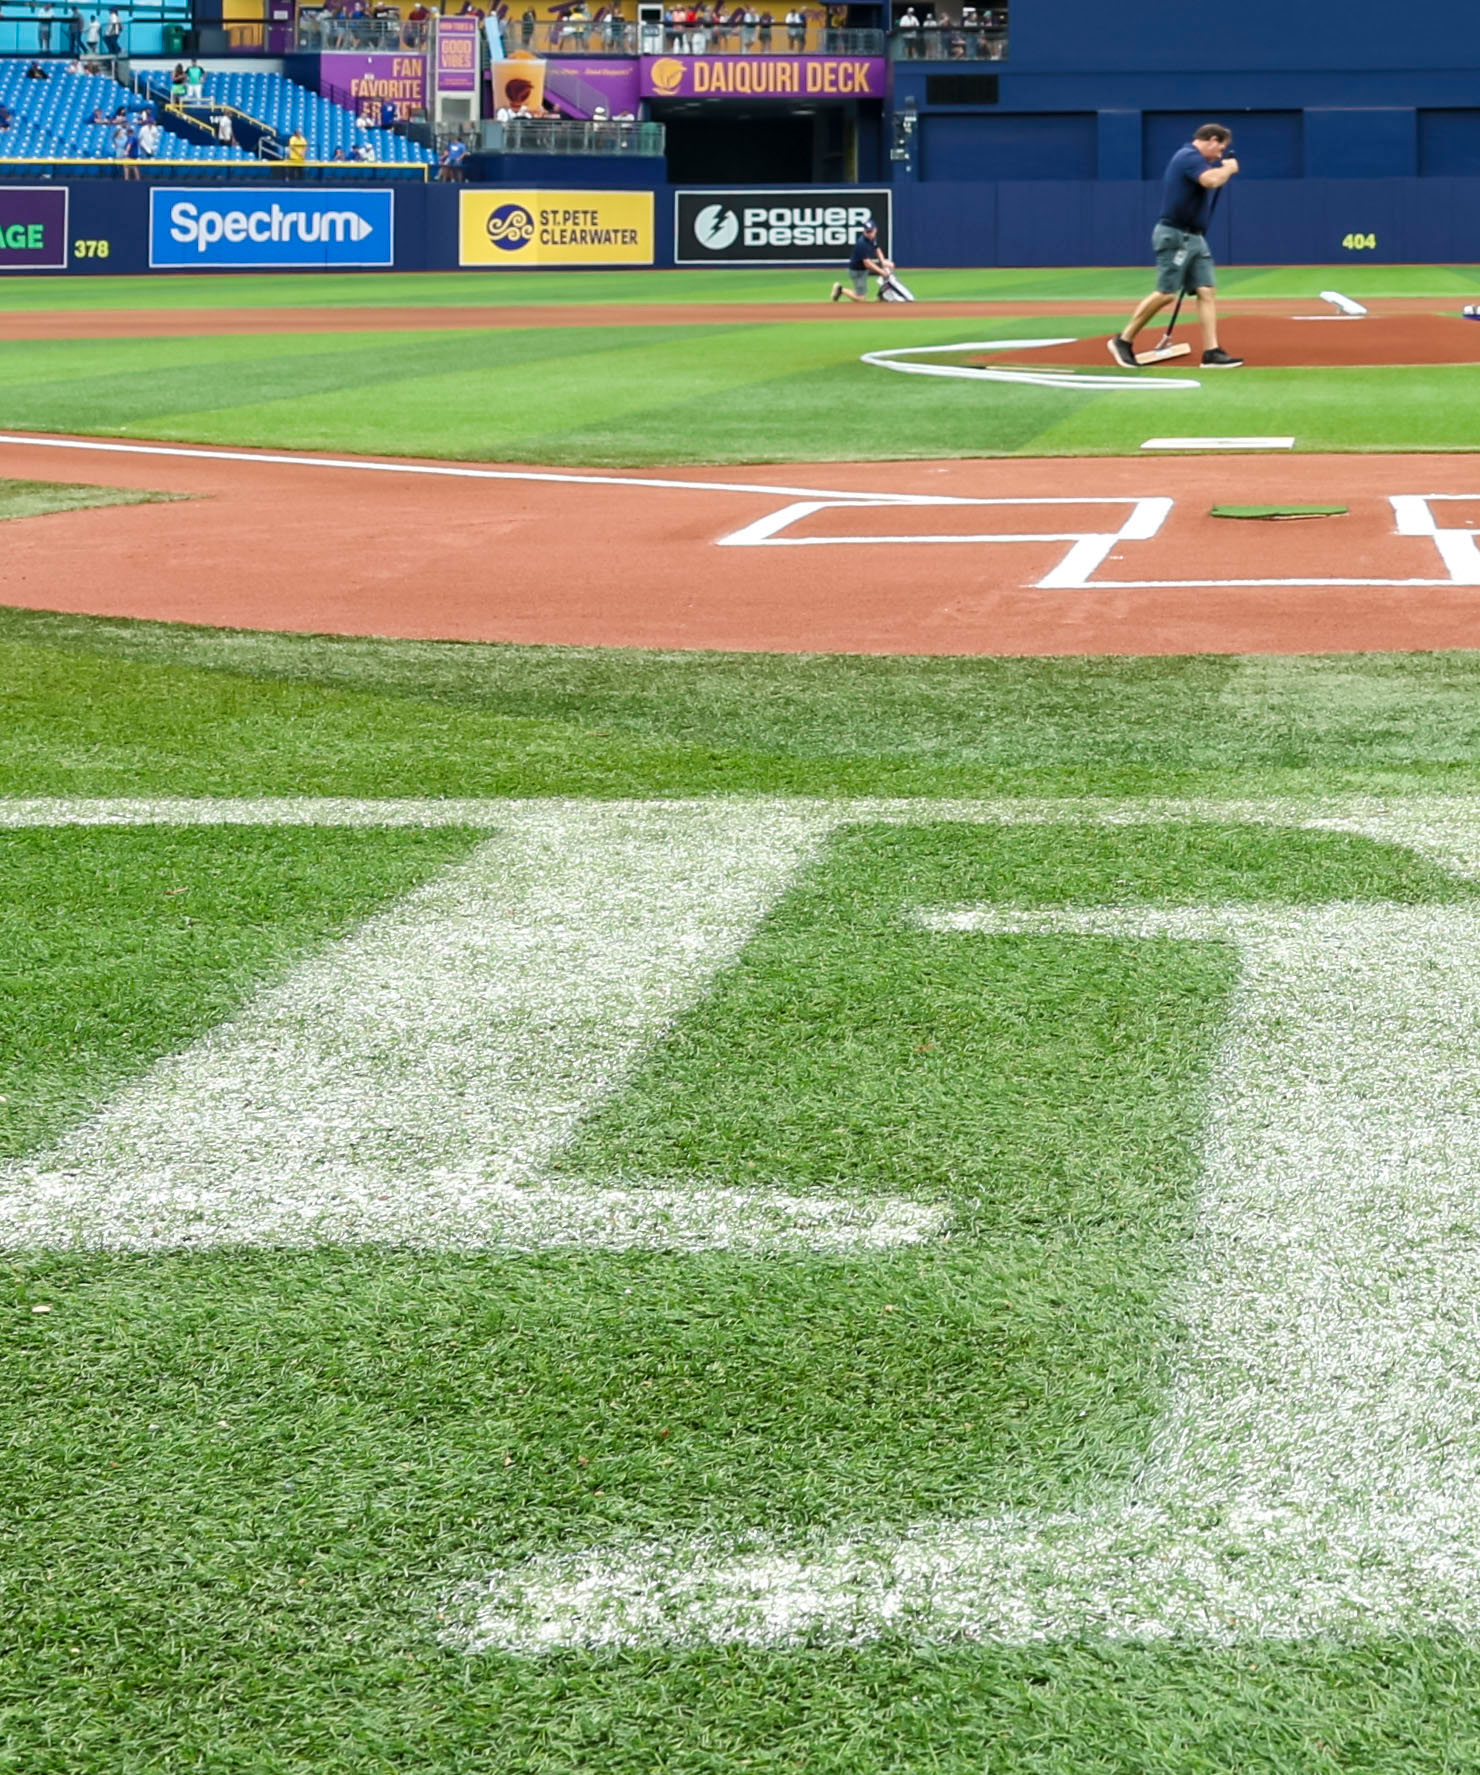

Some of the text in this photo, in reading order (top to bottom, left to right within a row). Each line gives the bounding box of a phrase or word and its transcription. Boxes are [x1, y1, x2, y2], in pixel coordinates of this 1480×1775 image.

[392, 57, 423, 78] FAN
[693, 60, 871, 94] DAIQUIRI DECK
[350, 78, 422, 99] FAVORITE
[169, 200, 358, 253] Spectrum
[540, 228, 639, 246] CLEARWATER
[74, 239, 109, 259] 378
[1342, 233, 1377, 250] 404
